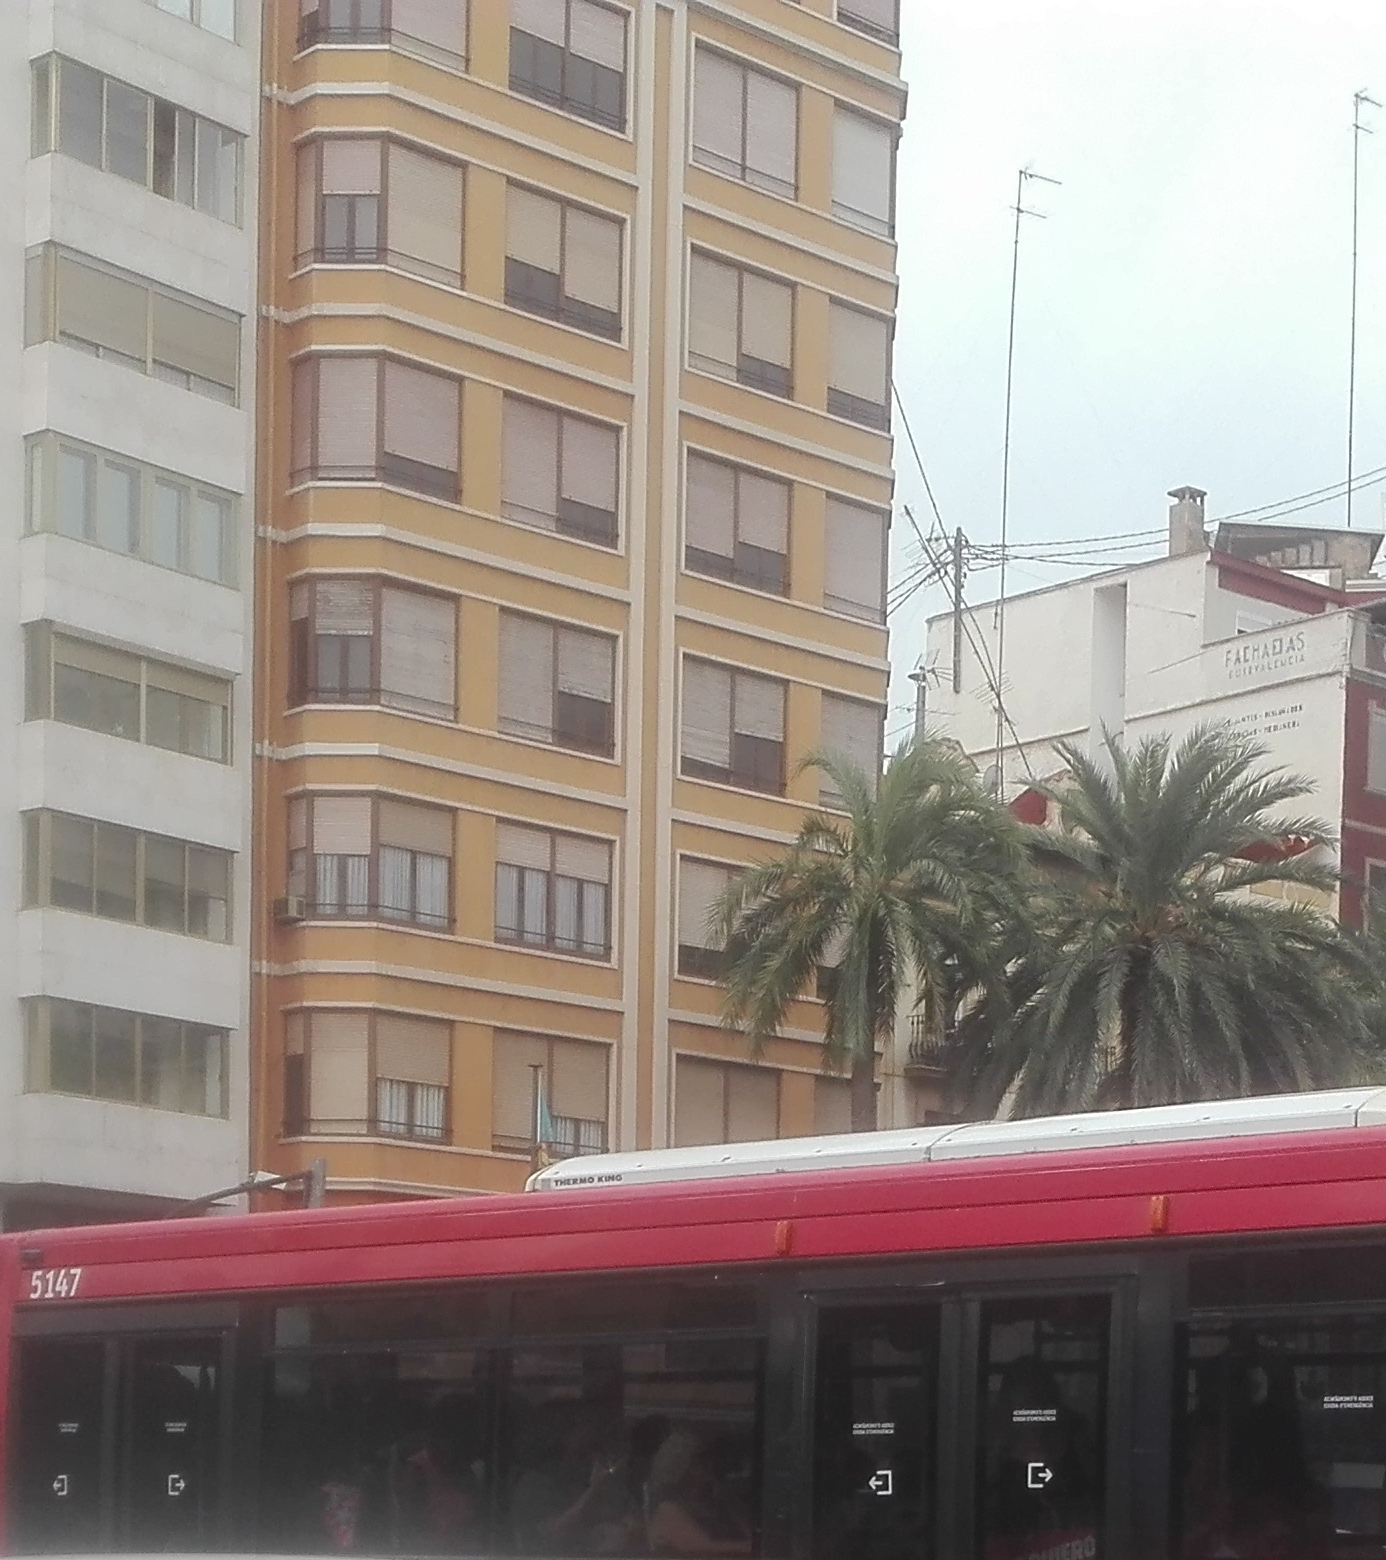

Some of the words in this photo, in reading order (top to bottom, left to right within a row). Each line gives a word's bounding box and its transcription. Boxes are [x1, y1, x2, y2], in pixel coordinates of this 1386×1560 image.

[1225, 631, 1305, 668] FACHADAS
[554, 1176, 595, 1187] THERMO
[597, 1174, 623, 1183] KING
[30, 1268, 82, 1299] 5147
